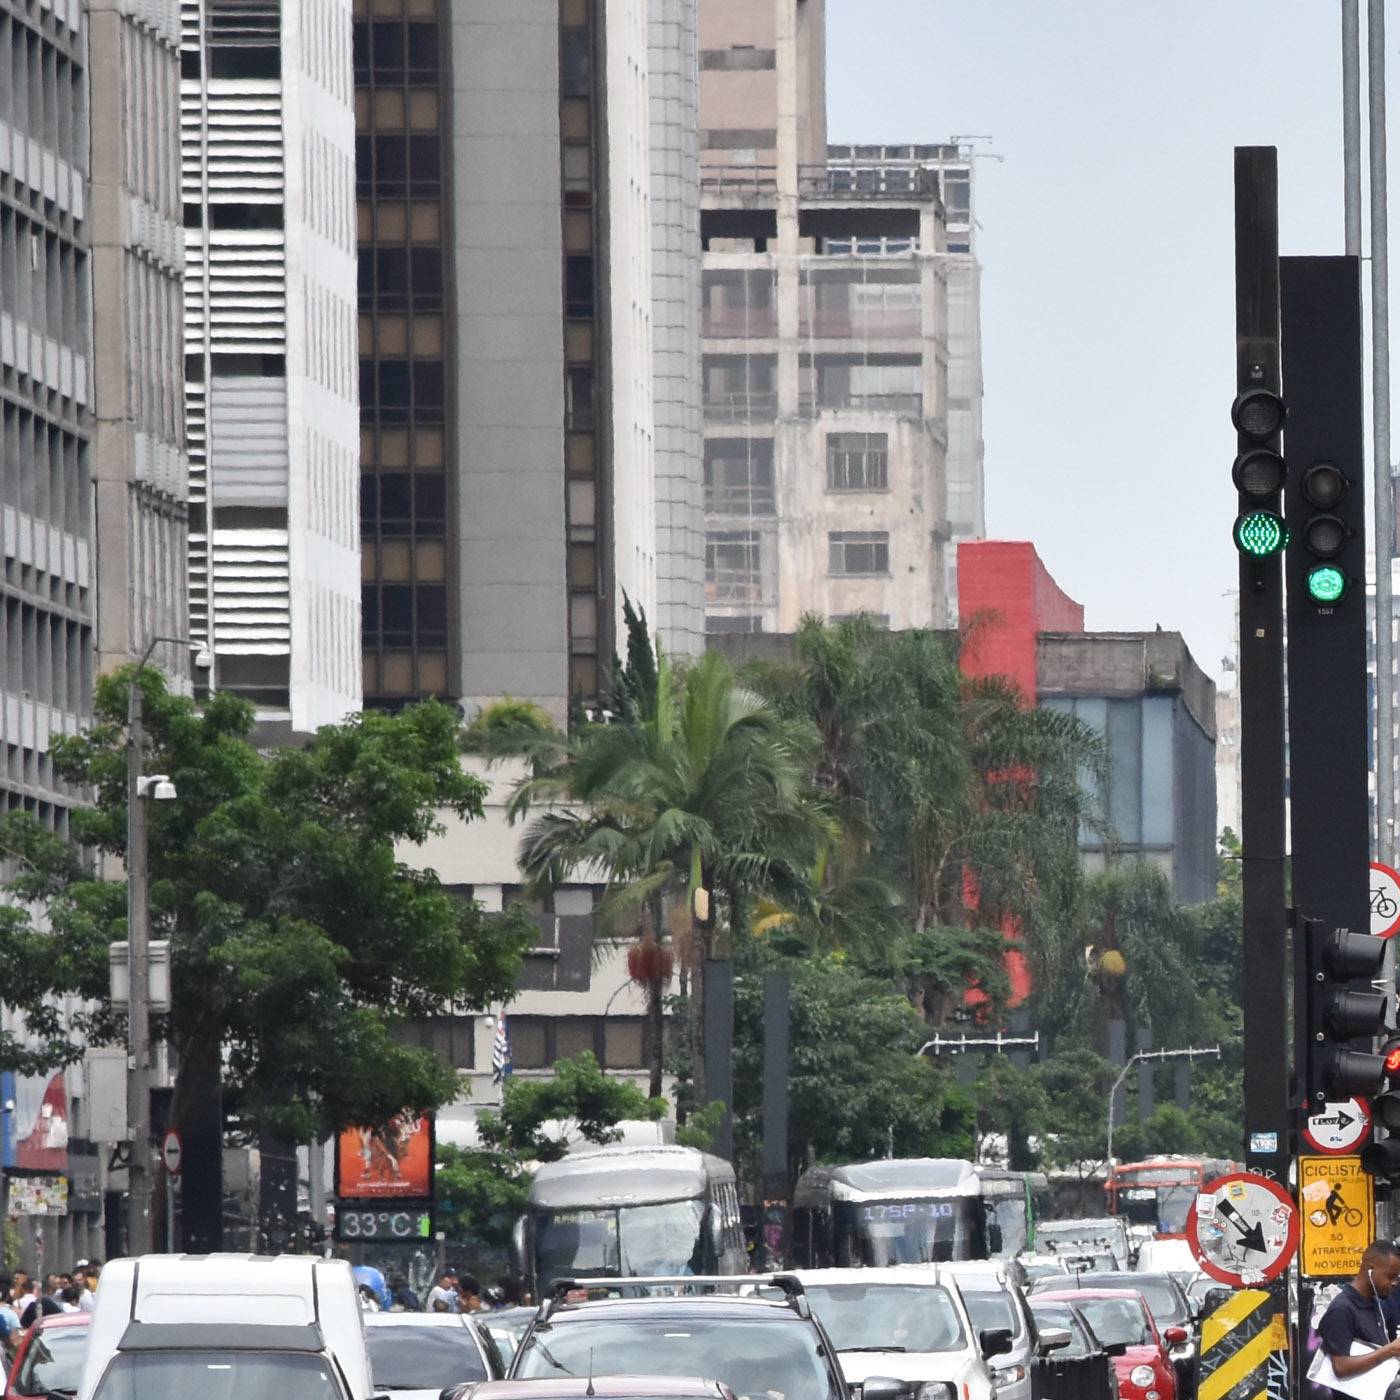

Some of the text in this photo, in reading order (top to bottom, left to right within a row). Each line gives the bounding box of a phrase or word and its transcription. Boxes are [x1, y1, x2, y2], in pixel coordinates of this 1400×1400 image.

[1305, 1164, 1363, 1177] CICLISTA
[344, 1212, 411, 1236] 33°C
[1314, 1261, 1329, 1269] NO
